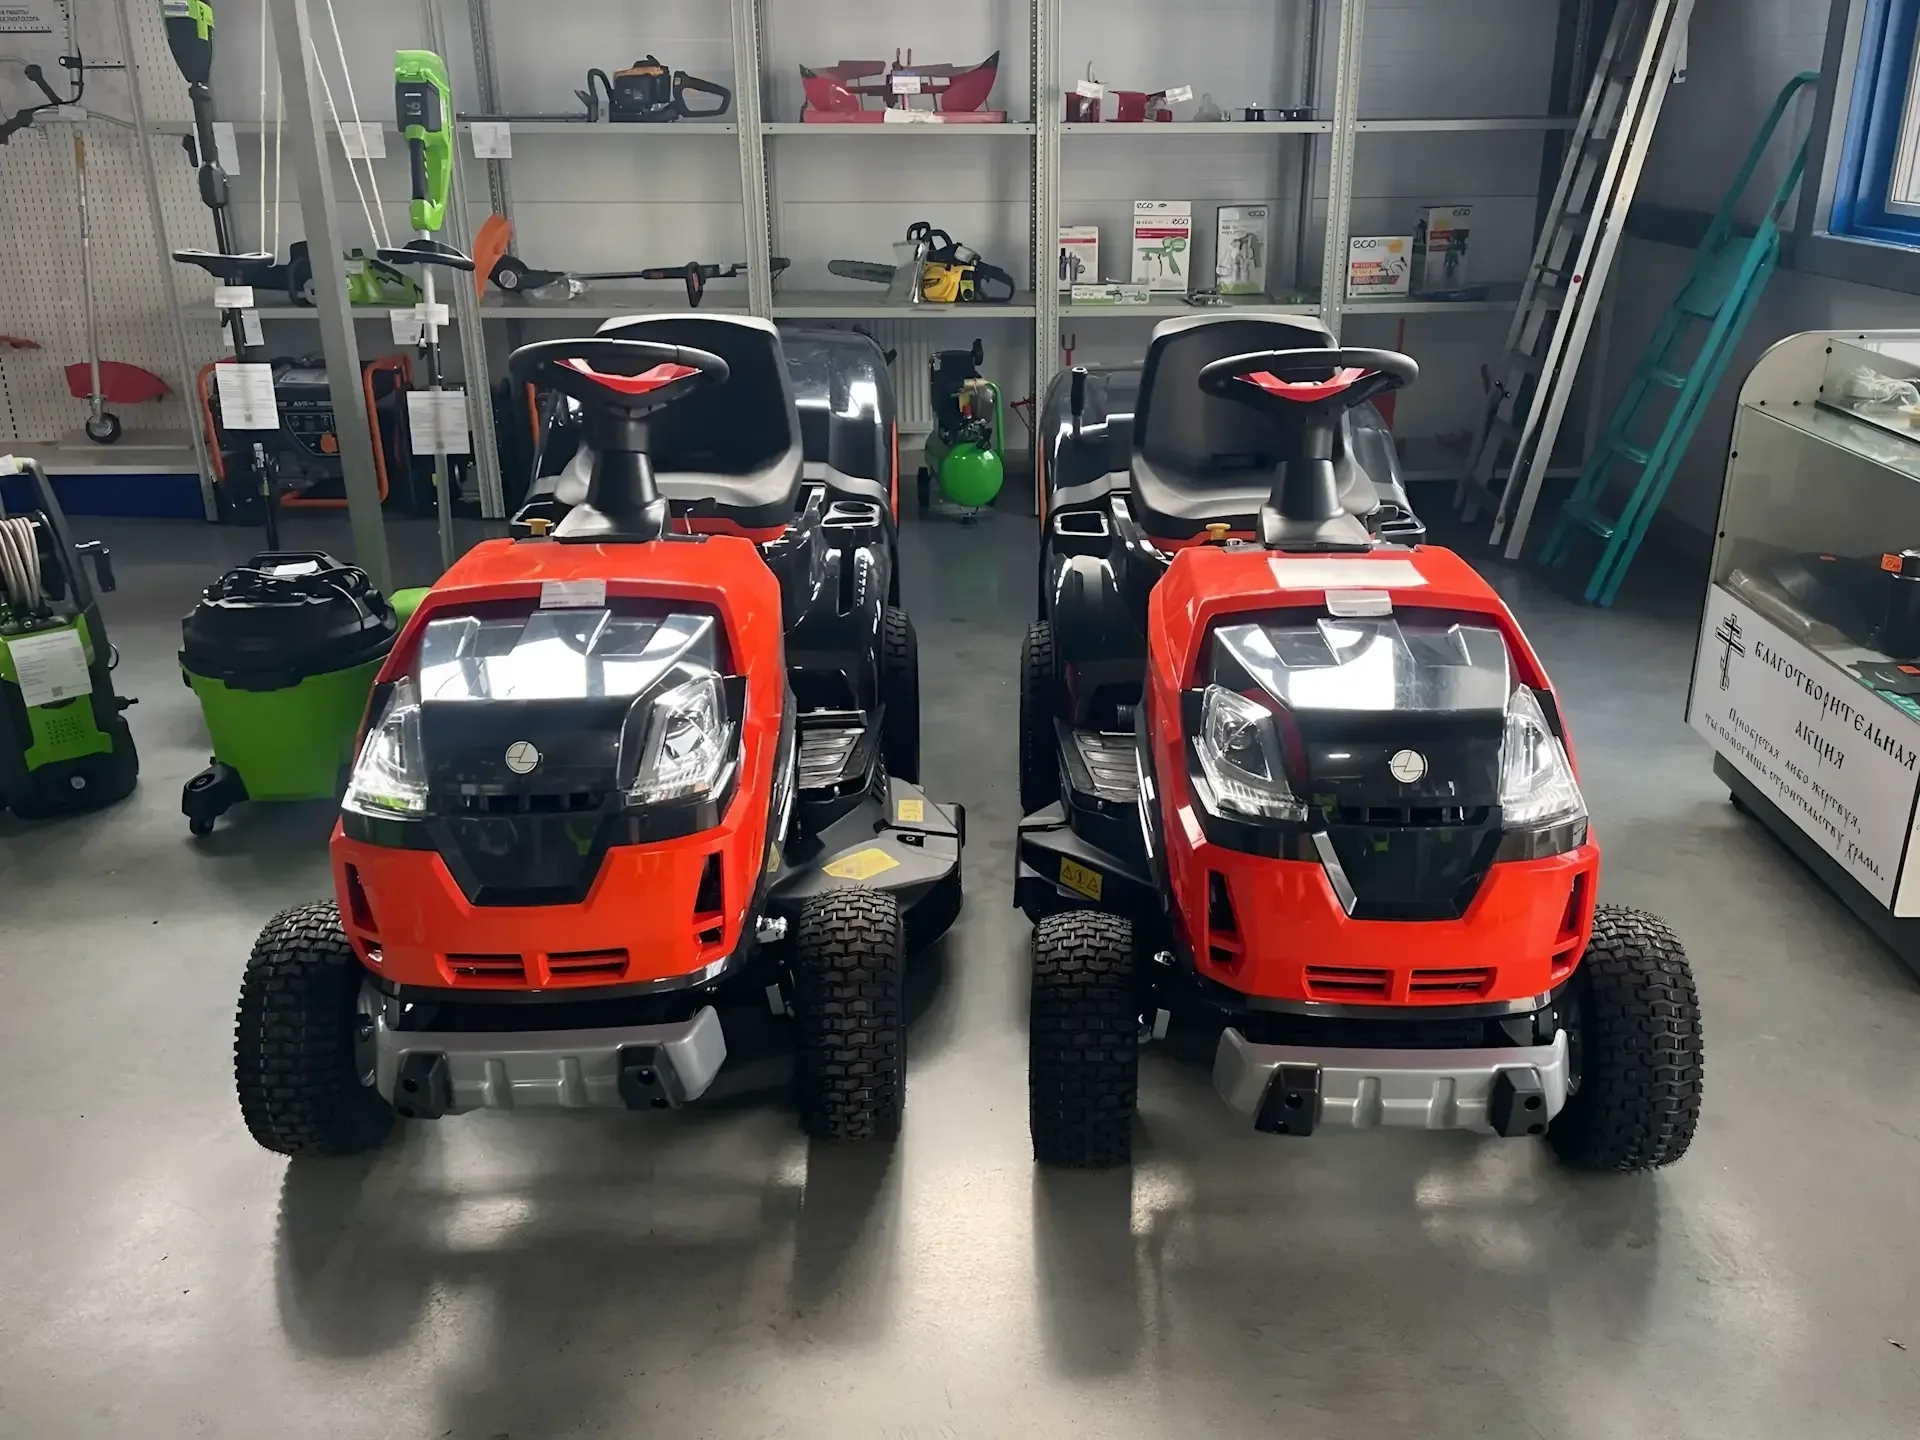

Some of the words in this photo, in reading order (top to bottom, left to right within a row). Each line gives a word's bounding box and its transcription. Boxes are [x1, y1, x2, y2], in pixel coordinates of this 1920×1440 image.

[1353, 239, 1376, 249] eco
[1754, 640, 1917, 771] БЛАГОТВОРИТЕЛЬНАЯ
[1794, 720, 1845, 770] АКЦИЯ
[1719, 726, 1767, 776] помогаешь
[1769, 771, 1845, 851] строительству
[1728, 707, 1780, 760] Приобретая
[1784, 760, 1809, 785] либо
[1811, 781, 1862, 835] жертвуя,
